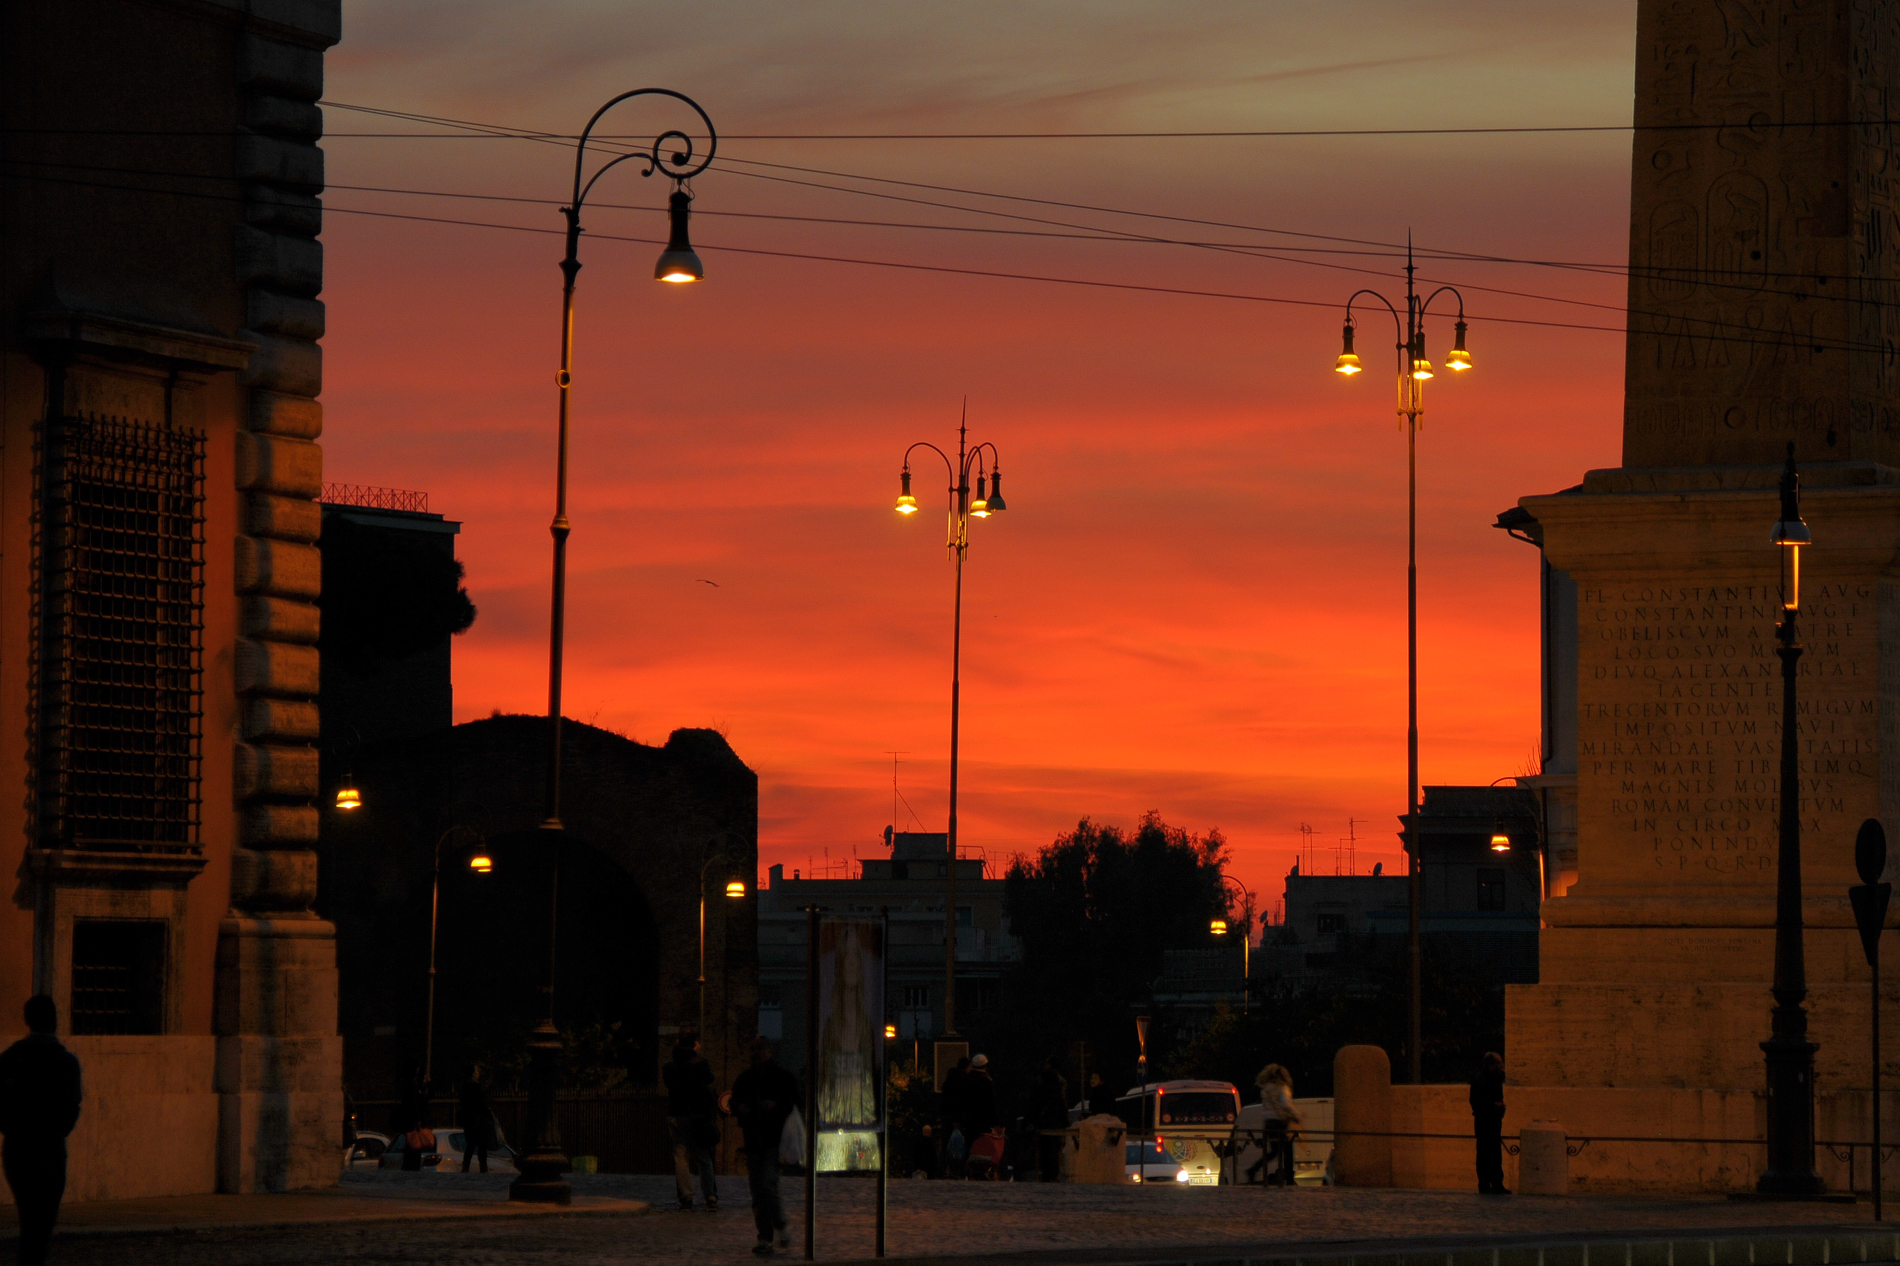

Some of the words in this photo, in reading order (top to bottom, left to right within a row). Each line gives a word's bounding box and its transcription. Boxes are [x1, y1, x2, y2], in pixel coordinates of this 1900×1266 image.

[1585, 589, 1606, 603] FL
[1622, 585, 1802, 603] CONSTANTIV
[1820, 584, 1870, 599] AVG
[1595, 605, 1777, 622] CONSTANTINI
[1601, 625, 1729, 641] OBELISCVM
[1748, 626, 1759, 638] A
[1792, 622, 1855, 638] ATRE
[1615, 645, 1679, 660] LOCO
[1694, 644, 1737, 659] SVO
[1751, 642, 1839, 658] MVM
[1595, 665, 1668, 682] DIVQ
[1671, 662, 1860, 679] ALEXANRIAE
[1583, 701, 1749, 718] TRECENTORVM
[1767, 700, 1874, 716] RMIGVM
[1614, 721, 1756, 737] IMPOSITVM
[1582, 740, 1714, 756] MIRANDAE
[1734, 739, 1873, 754] VASTATIS
[1593, 760, 1636, 775] PER
[1653, 760, 1717, 775] MARE
[1733, 759, 1874, 778] TIBRIMQ
[1622, 779, 1715, 794] MAGNIS
[1735, 779, 1834, 793] MOLBVS
[1612, 799, 1690, 813] ROMAM
[1704, 798, 1844, 813] CONVETVM
[1633, 818, 1657, 832] IN
[1676, 818, 1750, 832] CIRCO
